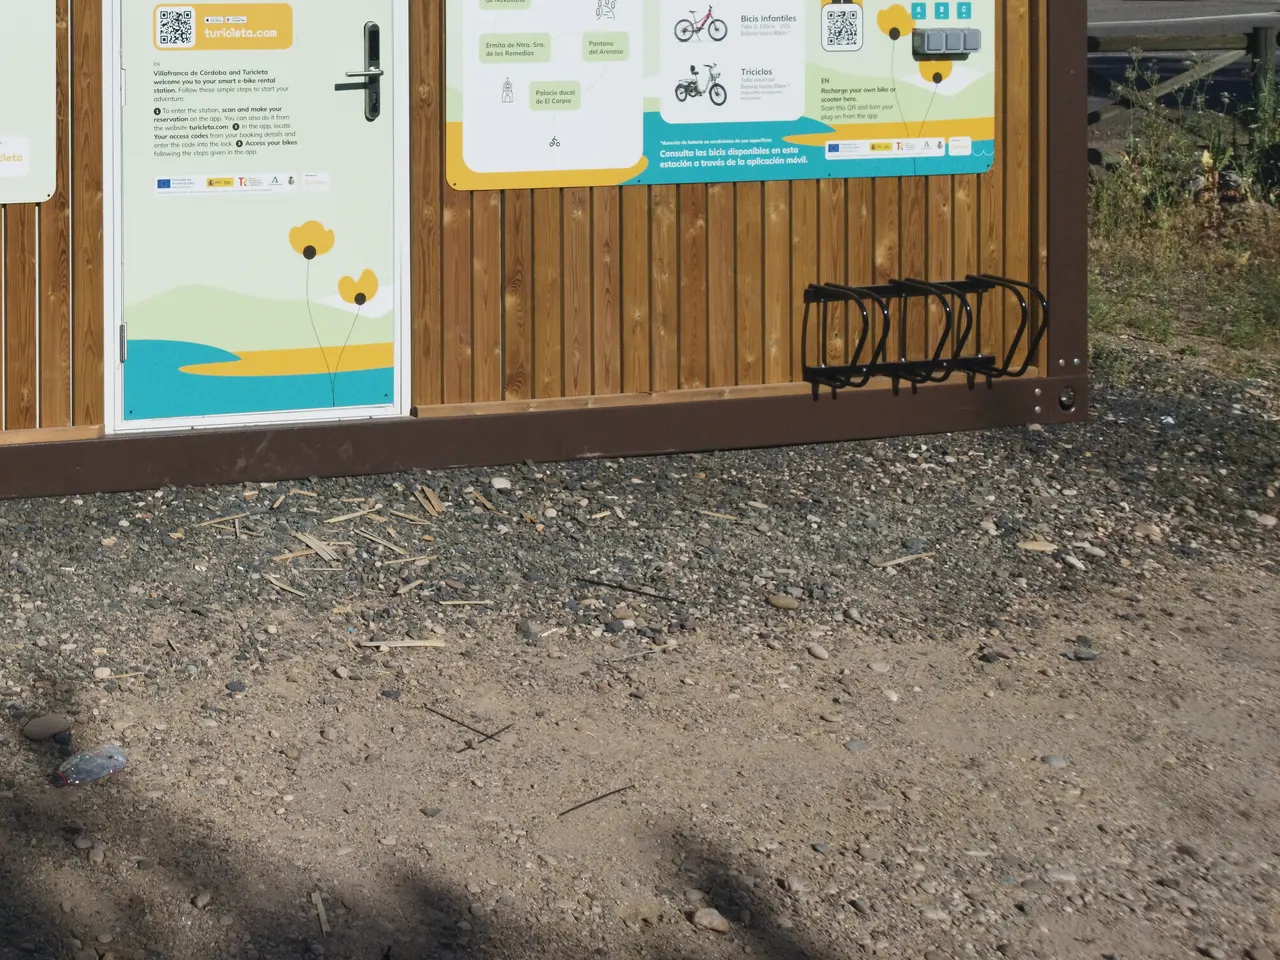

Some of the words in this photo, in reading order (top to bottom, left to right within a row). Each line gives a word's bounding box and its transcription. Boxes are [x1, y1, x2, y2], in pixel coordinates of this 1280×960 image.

[204, 28, 277, 38] turicleta.com
[741, 68, 772, 76] Triciclos
[660, 149, 694, 157] Consulta
[696, 149, 707, 157] las
[709, 148, 726, 156] bicis
[728, 147, 770, 157] disponibles
[782, 146, 800, 154] esta
[660, 160, 692, 168] estación
[701, 159, 725, 167] través
[747, 157, 785, 166] aplicación
[786, 156, 808, 164] móvil.
